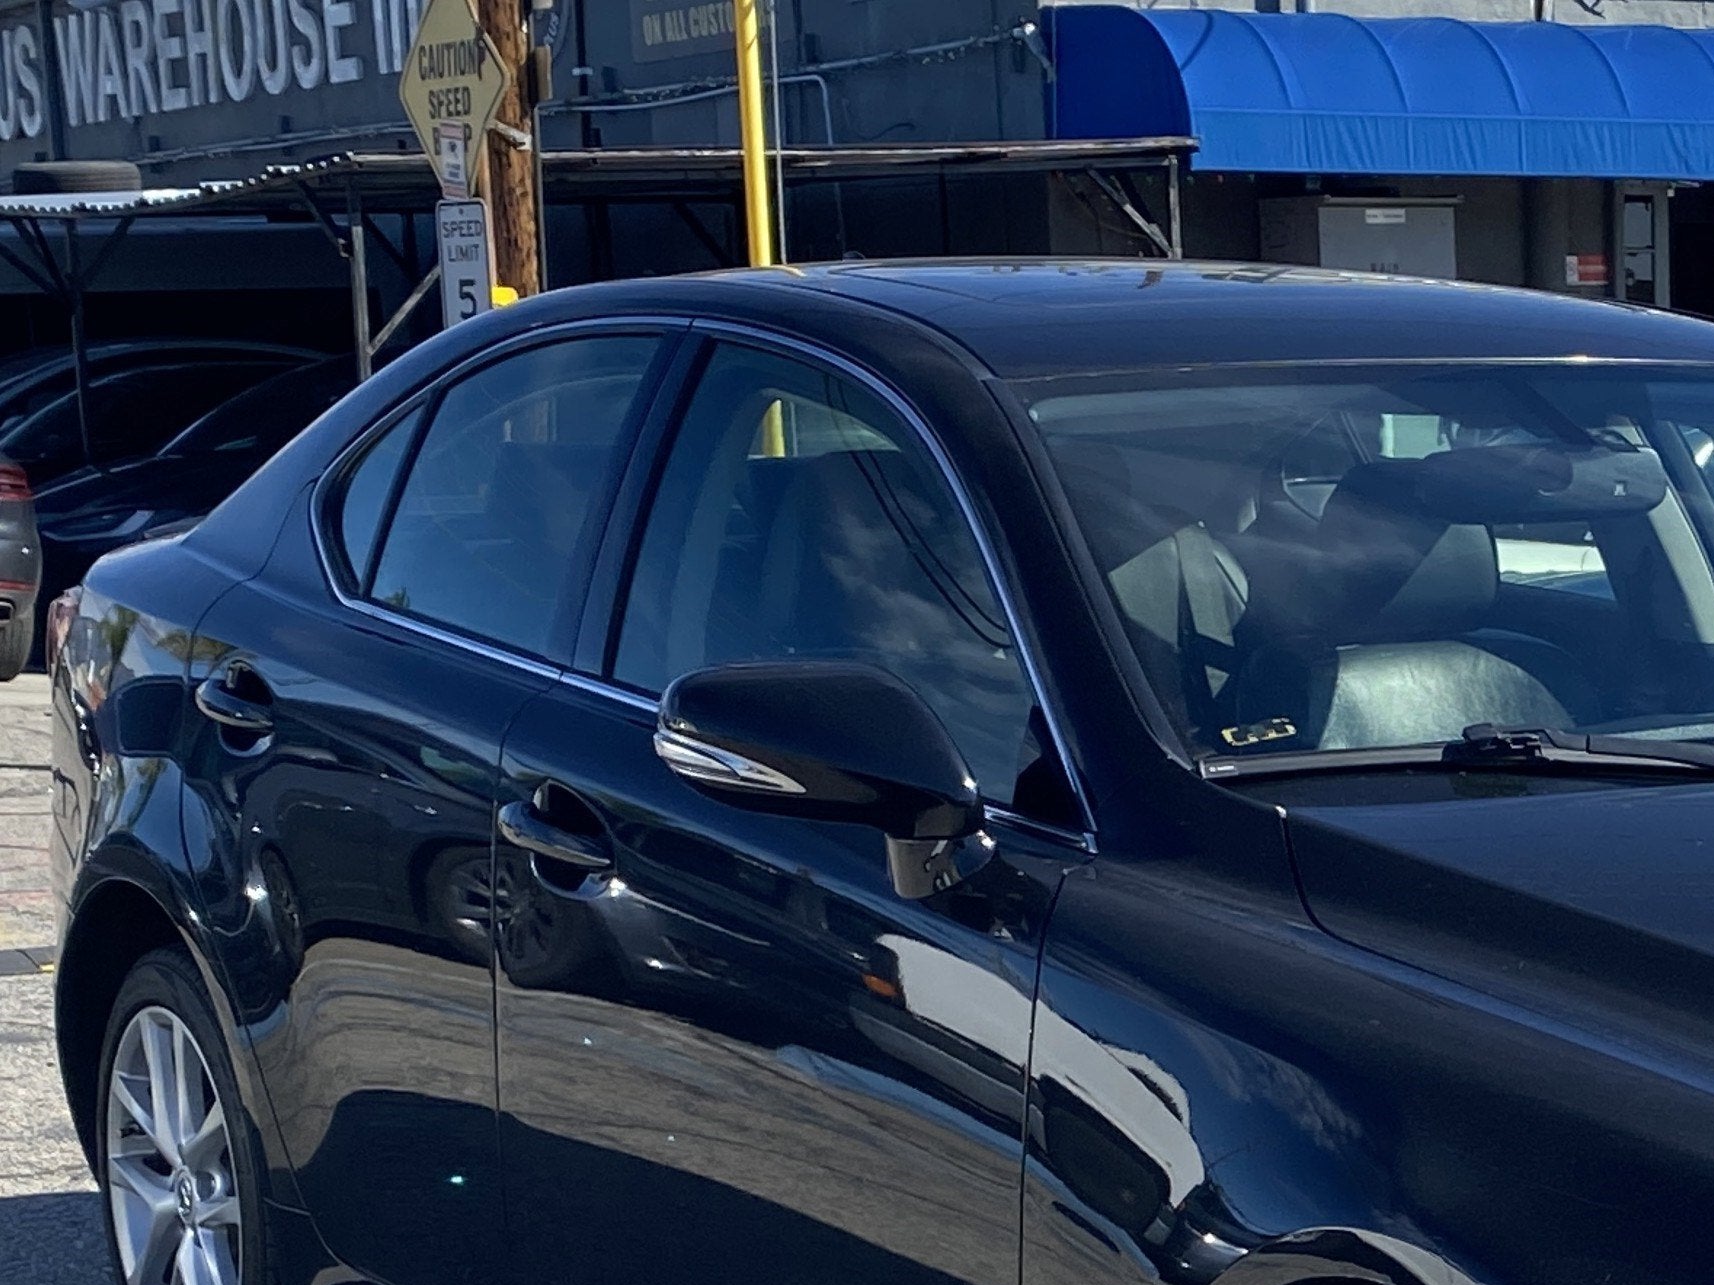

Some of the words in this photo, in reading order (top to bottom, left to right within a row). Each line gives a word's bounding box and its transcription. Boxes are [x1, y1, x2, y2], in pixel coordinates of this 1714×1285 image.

[642, 14, 663, 46] ON
[665, 9, 689, 42] ALL
[688, 2, 735, 38] CUSTO
[53, 0, 364, 127] WAREHOUSE
[418, 39, 478, 81] CAUTION
[428, 86, 472, 120] SPEED
[432, 122, 473, 156] BP
[442, 219, 483, 239] SPEED
[448, 243, 480, 263] LIMIT
[458, 278, 478, 320] 5
